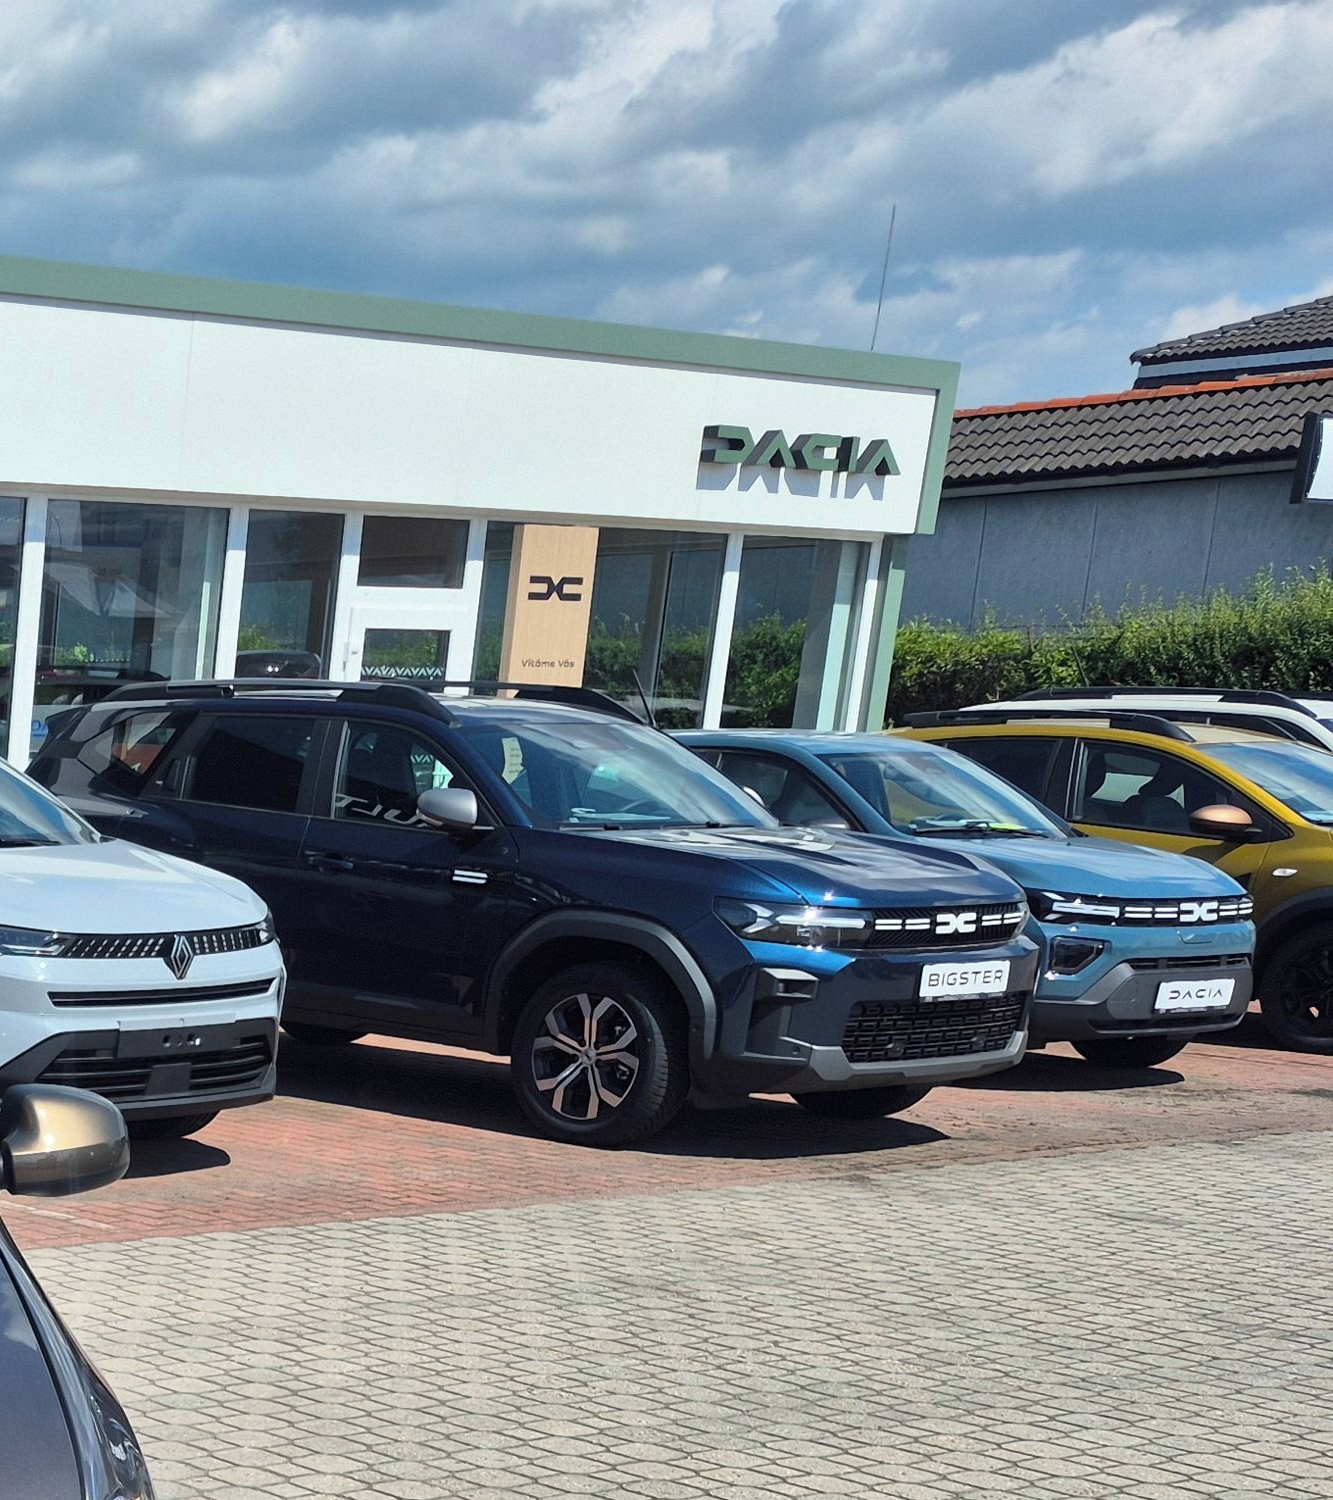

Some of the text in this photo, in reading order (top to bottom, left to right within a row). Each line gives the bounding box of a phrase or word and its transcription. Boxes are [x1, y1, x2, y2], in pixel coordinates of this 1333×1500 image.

[700, 424, 901, 476] DACIA
[521, 659, 575, 668] Vítáme Vás
[928, 969, 1004, 987] BIGSTER
[1168, 988, 1223, 1000] DACIA
